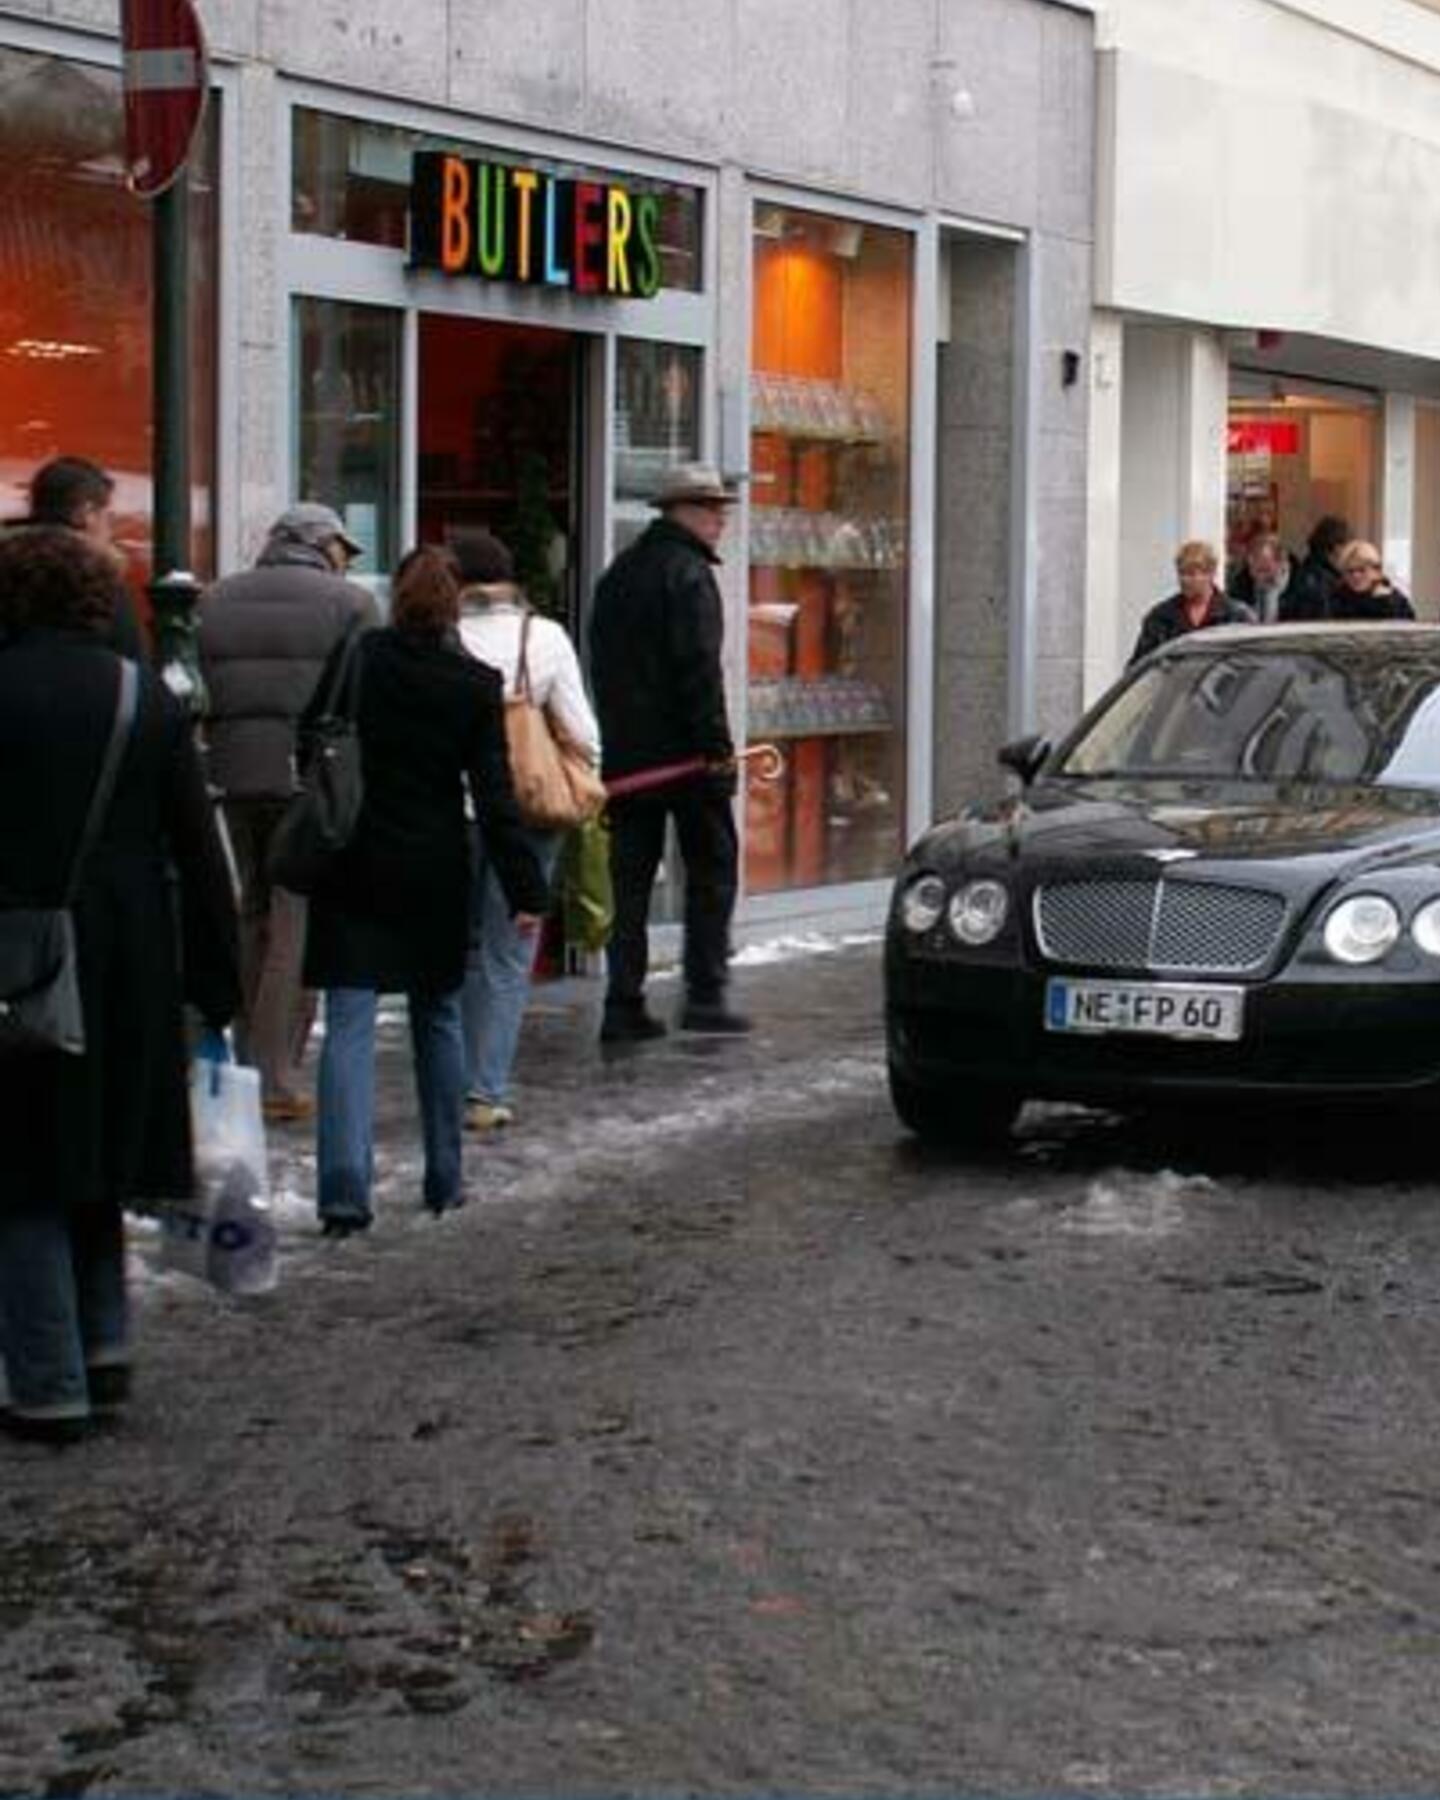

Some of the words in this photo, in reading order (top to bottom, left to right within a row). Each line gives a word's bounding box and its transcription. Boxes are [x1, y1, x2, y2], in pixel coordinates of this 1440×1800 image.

[441, 154, 661, 298] BUTLERS
[1073, 991, 1113, 1023] NE
[1134, 995, 1175, 1026] FP
[1183, 998, 1222, 1029] 60
